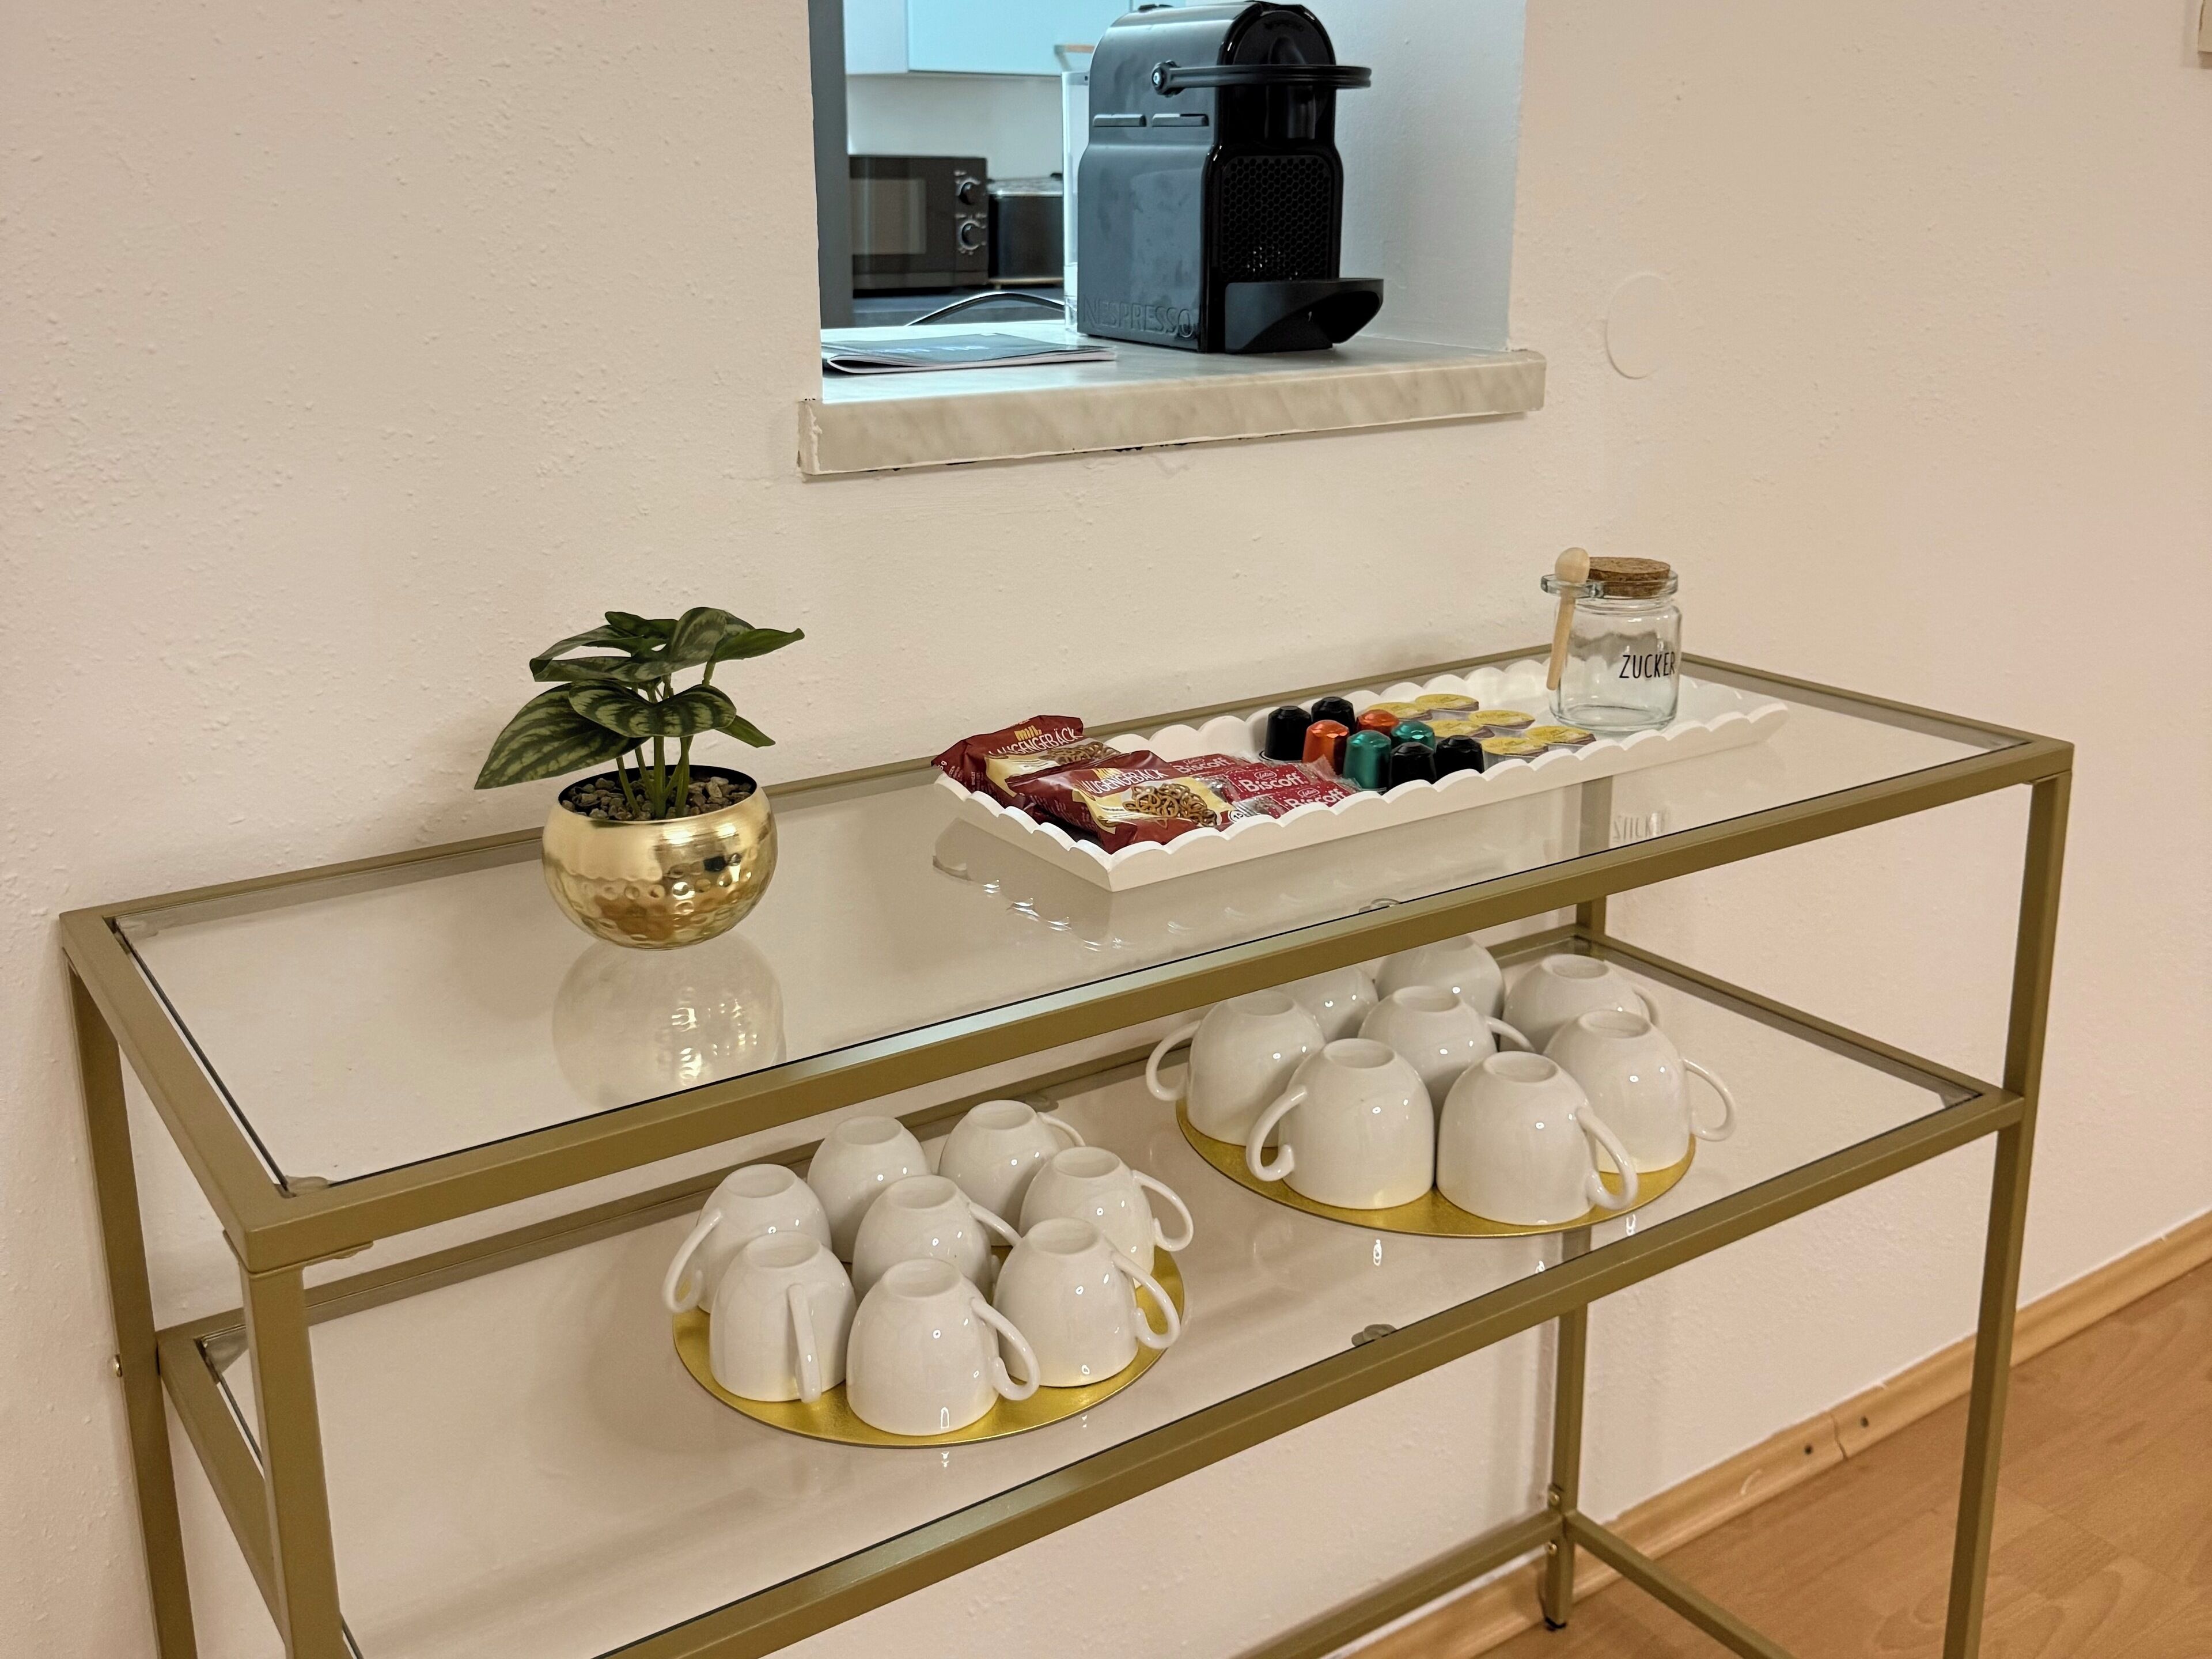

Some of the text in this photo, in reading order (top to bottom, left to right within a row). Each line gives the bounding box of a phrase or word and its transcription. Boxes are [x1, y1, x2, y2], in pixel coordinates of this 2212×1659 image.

[1083, 295, 1194, 338] NESPRESSO
[1619, 652, 1675, 679] ZUCKER
[1173, 757, 1230, 774] Biscoff
[1238, 772, 1302, 792] Biscoff
